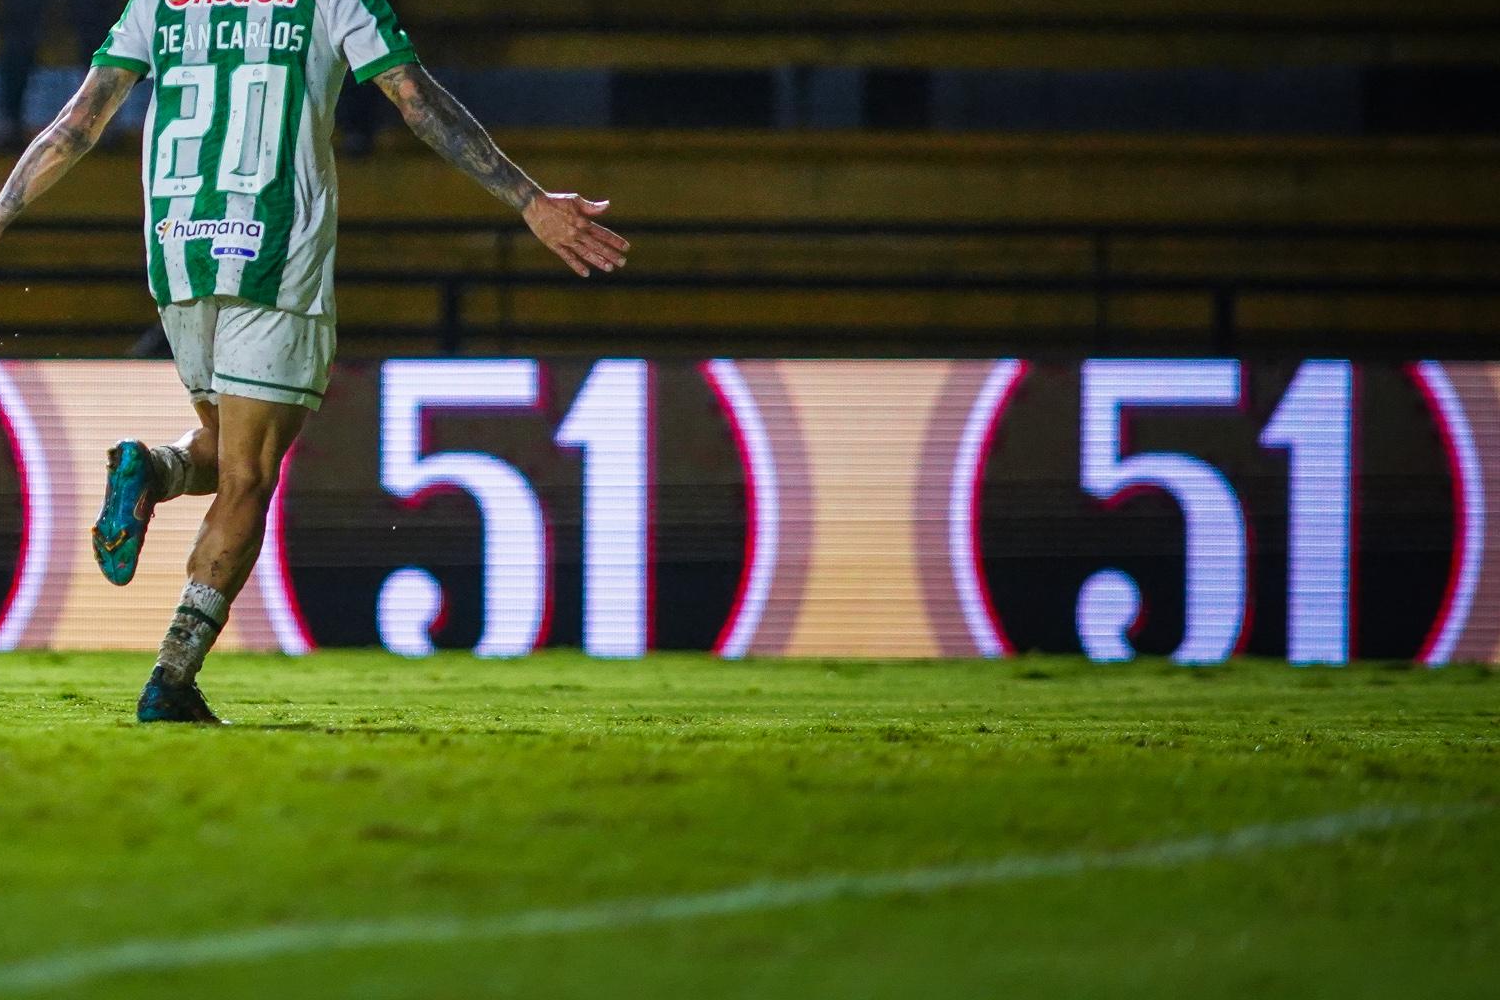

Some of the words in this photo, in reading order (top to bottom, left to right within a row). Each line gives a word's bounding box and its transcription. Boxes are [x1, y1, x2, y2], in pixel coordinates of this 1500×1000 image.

[158, 22, 211, 54] JEAN
[216, 21, 305, 51] CARLOS
[152, 65, 288, 196] 20
[173, 220, 261, 238] humana
